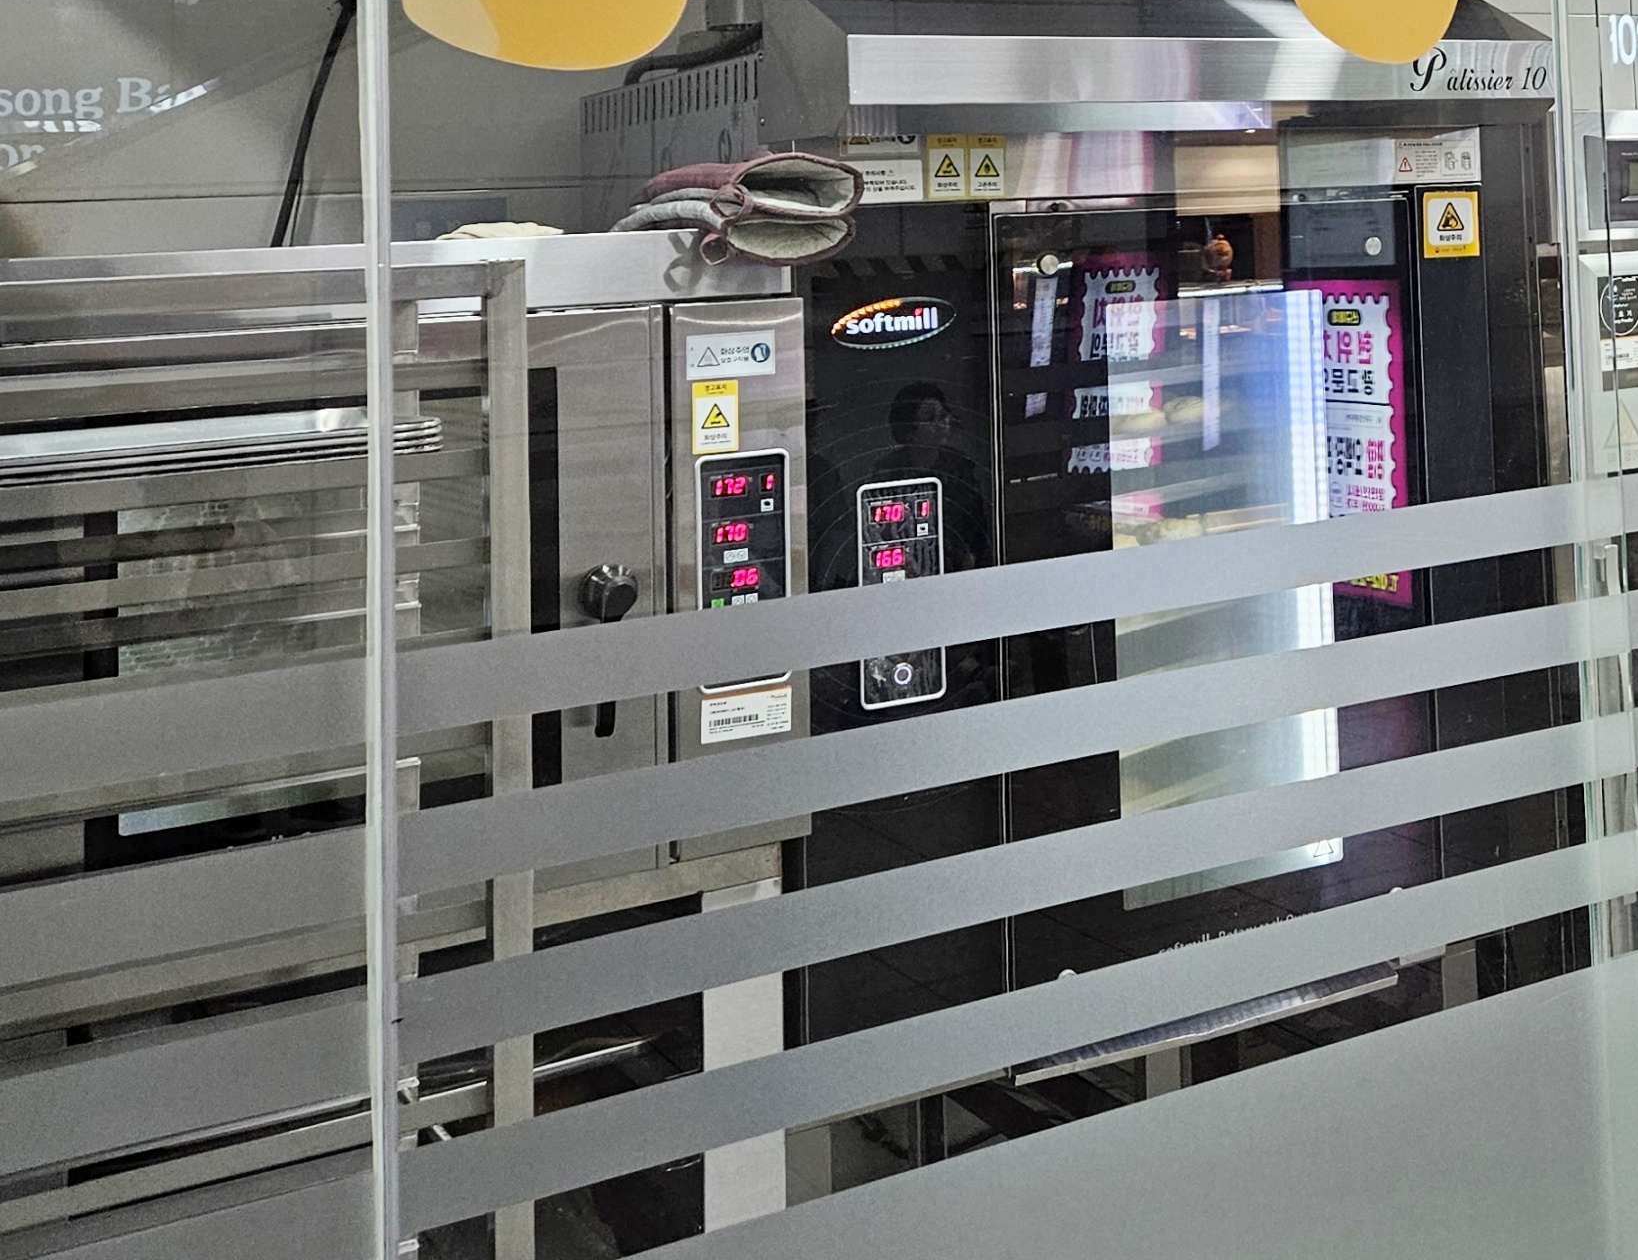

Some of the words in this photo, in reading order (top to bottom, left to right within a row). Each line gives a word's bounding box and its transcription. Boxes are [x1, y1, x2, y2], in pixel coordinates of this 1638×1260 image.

[1521, 66, 1547, 90] 10
[845, 306, 939, 336] softmill
[715, 475, 747, 496] 172
[874, 502, 904, 522] 170
[715, 523, 748, 543] 170
[874, 547, 904, 567] 166
